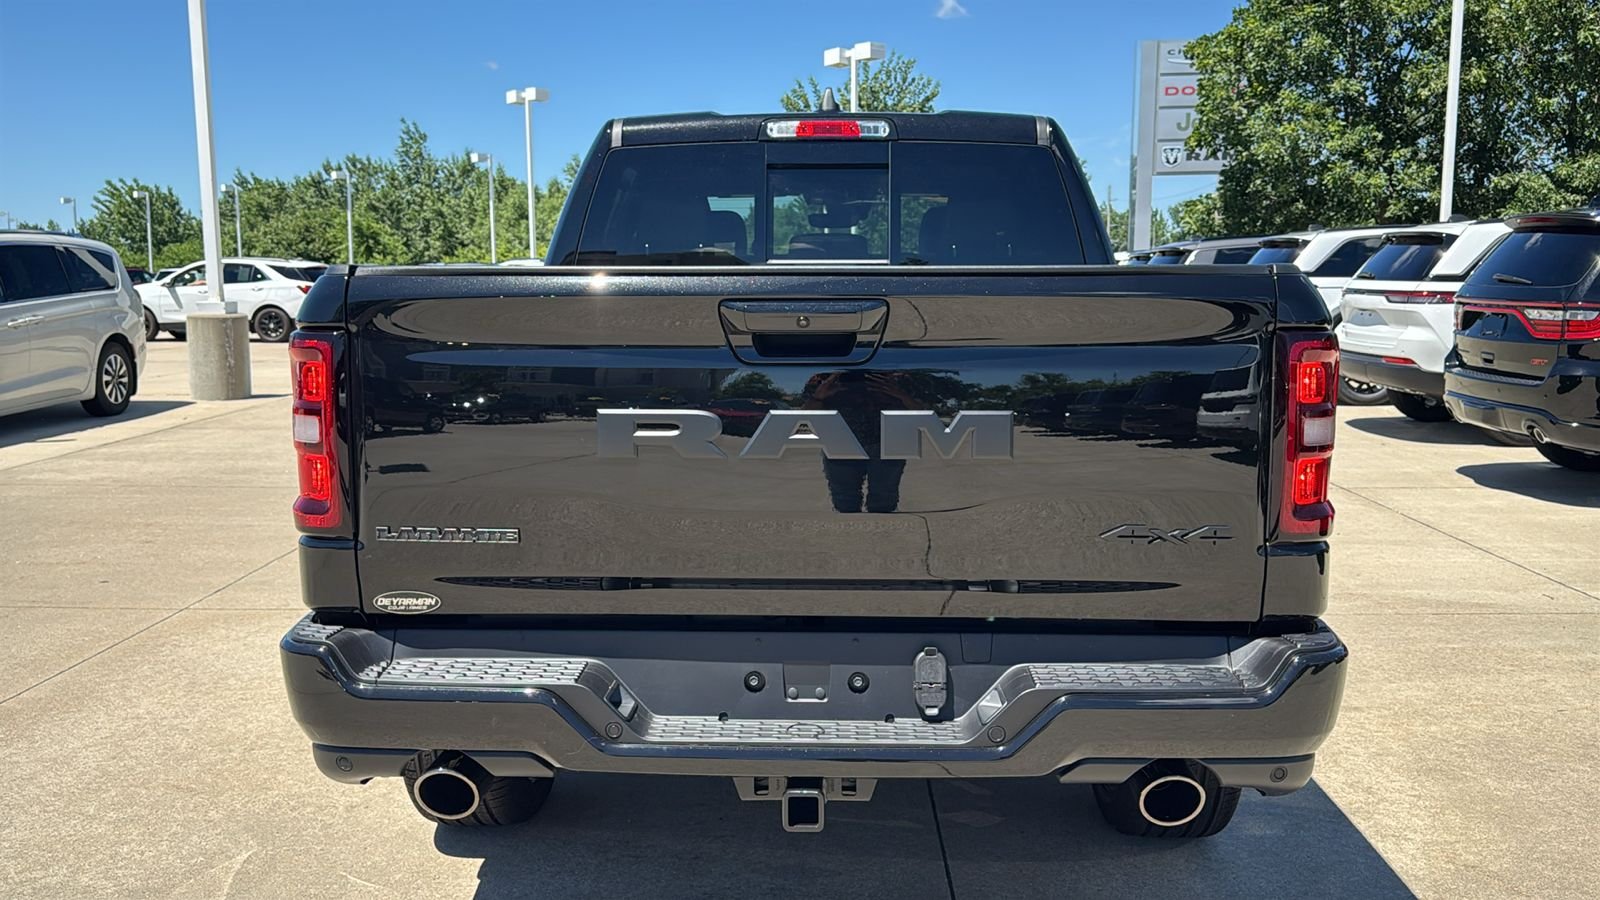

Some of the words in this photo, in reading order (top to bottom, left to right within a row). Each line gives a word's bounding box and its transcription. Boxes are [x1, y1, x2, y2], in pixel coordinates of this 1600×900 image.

[597, 409, 1013, 459] RAM
[376, 527, 520, 543] LARAMIE
[377, 597, 436, 606] DEYARMAN
